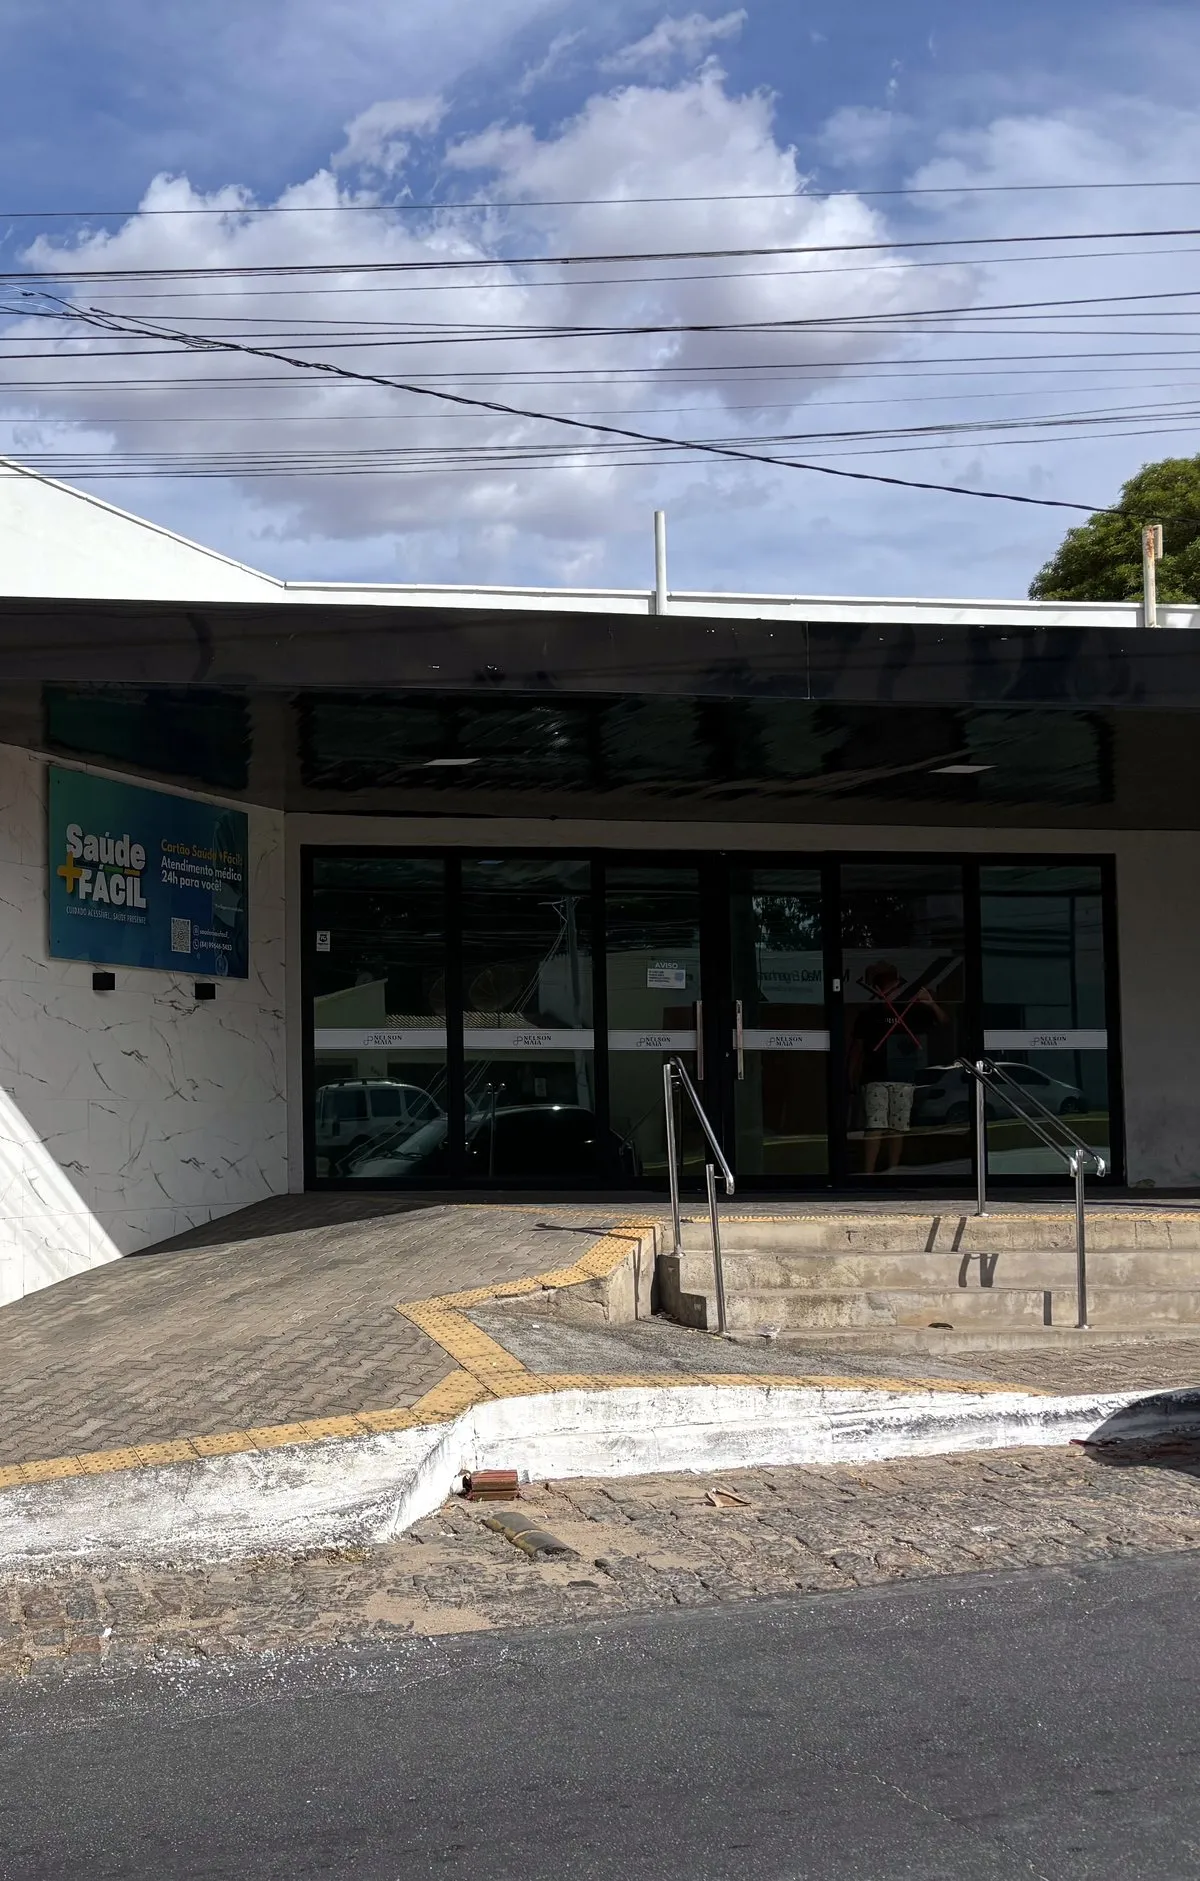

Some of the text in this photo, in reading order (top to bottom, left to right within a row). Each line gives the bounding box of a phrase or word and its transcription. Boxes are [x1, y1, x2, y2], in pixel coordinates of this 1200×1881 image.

[65, 823, 146, 871] Saúde
[161, 838, 190, 856] Cartão
[160, 855, 242, 882] Atendimento médico
[161, 869, 223, 892] 24h para você!
[655, 962, 678, 970] AVISO
